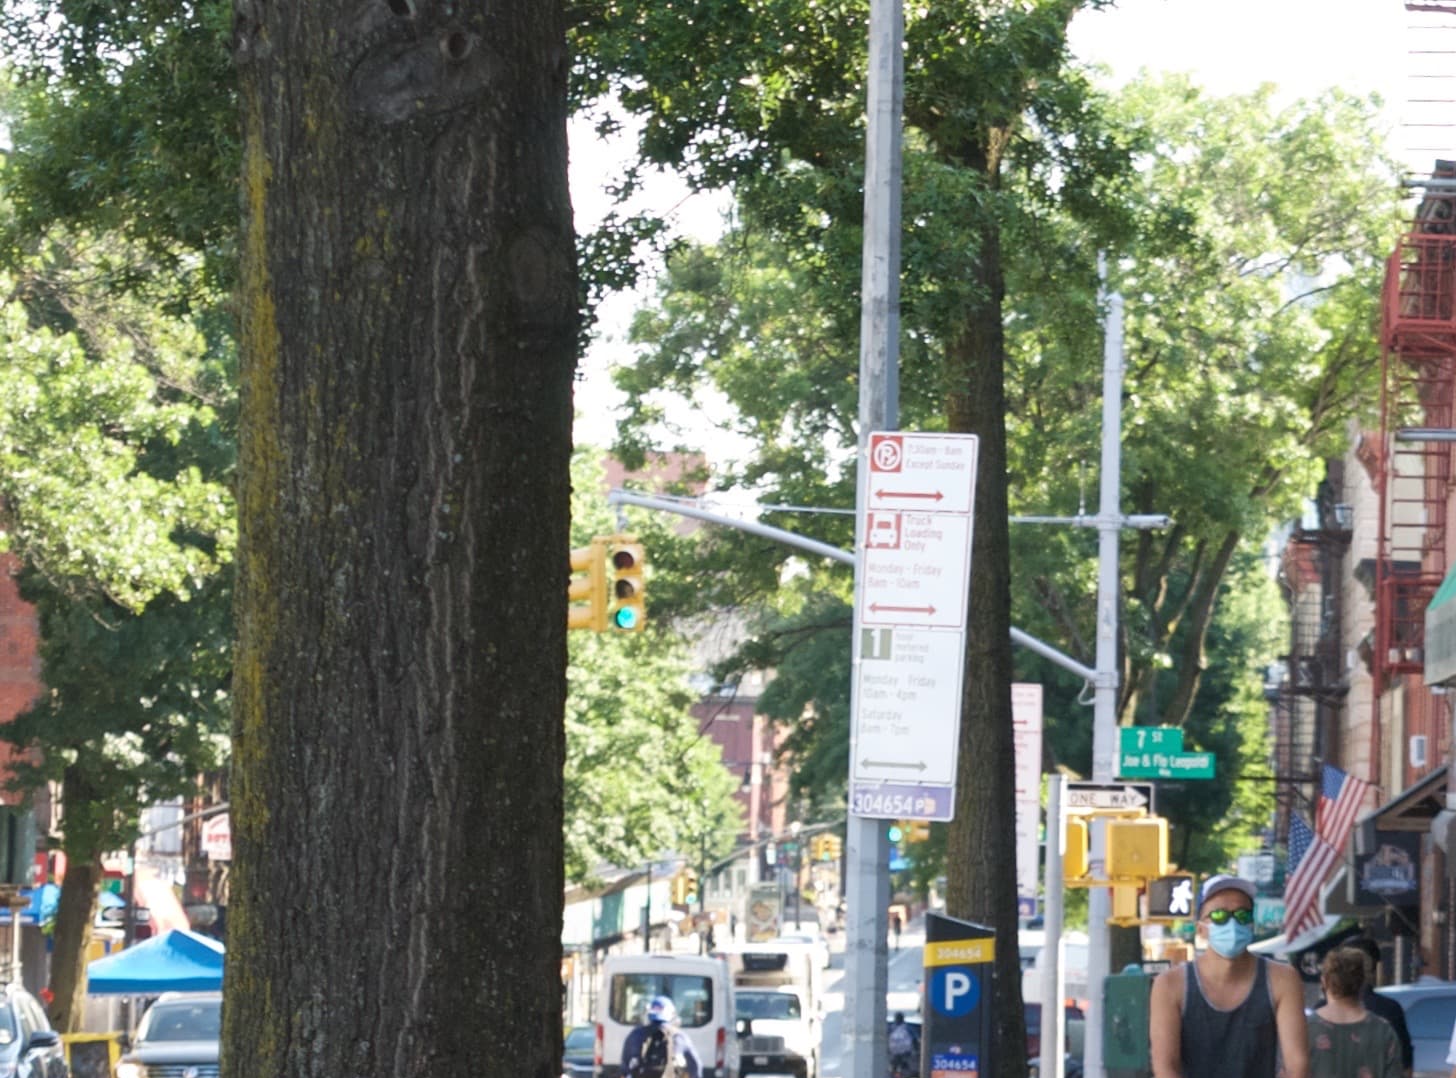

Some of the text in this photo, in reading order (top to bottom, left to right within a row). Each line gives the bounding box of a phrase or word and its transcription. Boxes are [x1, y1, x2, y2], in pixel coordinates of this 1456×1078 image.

[907, 514, 932, 525] Truck
[904, 528, 943, 541] Loading
[904, 540, 926, 552] Only
[868, 563, 904, 575] Monday
[913, 564, 943, 577] Friday
[871, 630, 880, 657] 1
[863, 674, 936, 688] Monday Friday
[863, 708, 902, 720] Saturday
[1136, 730, 1147, 750] 7
[1122, 755, 1139, 768] Joe
[1141, 754, 1151, 768] &
[855, 793, 912, 814] 304654
[1070, 792, 1137, 806] ONE WAY
[945, 972, 971, 1011] P
[933, 1058, 976, 1071] 304654
